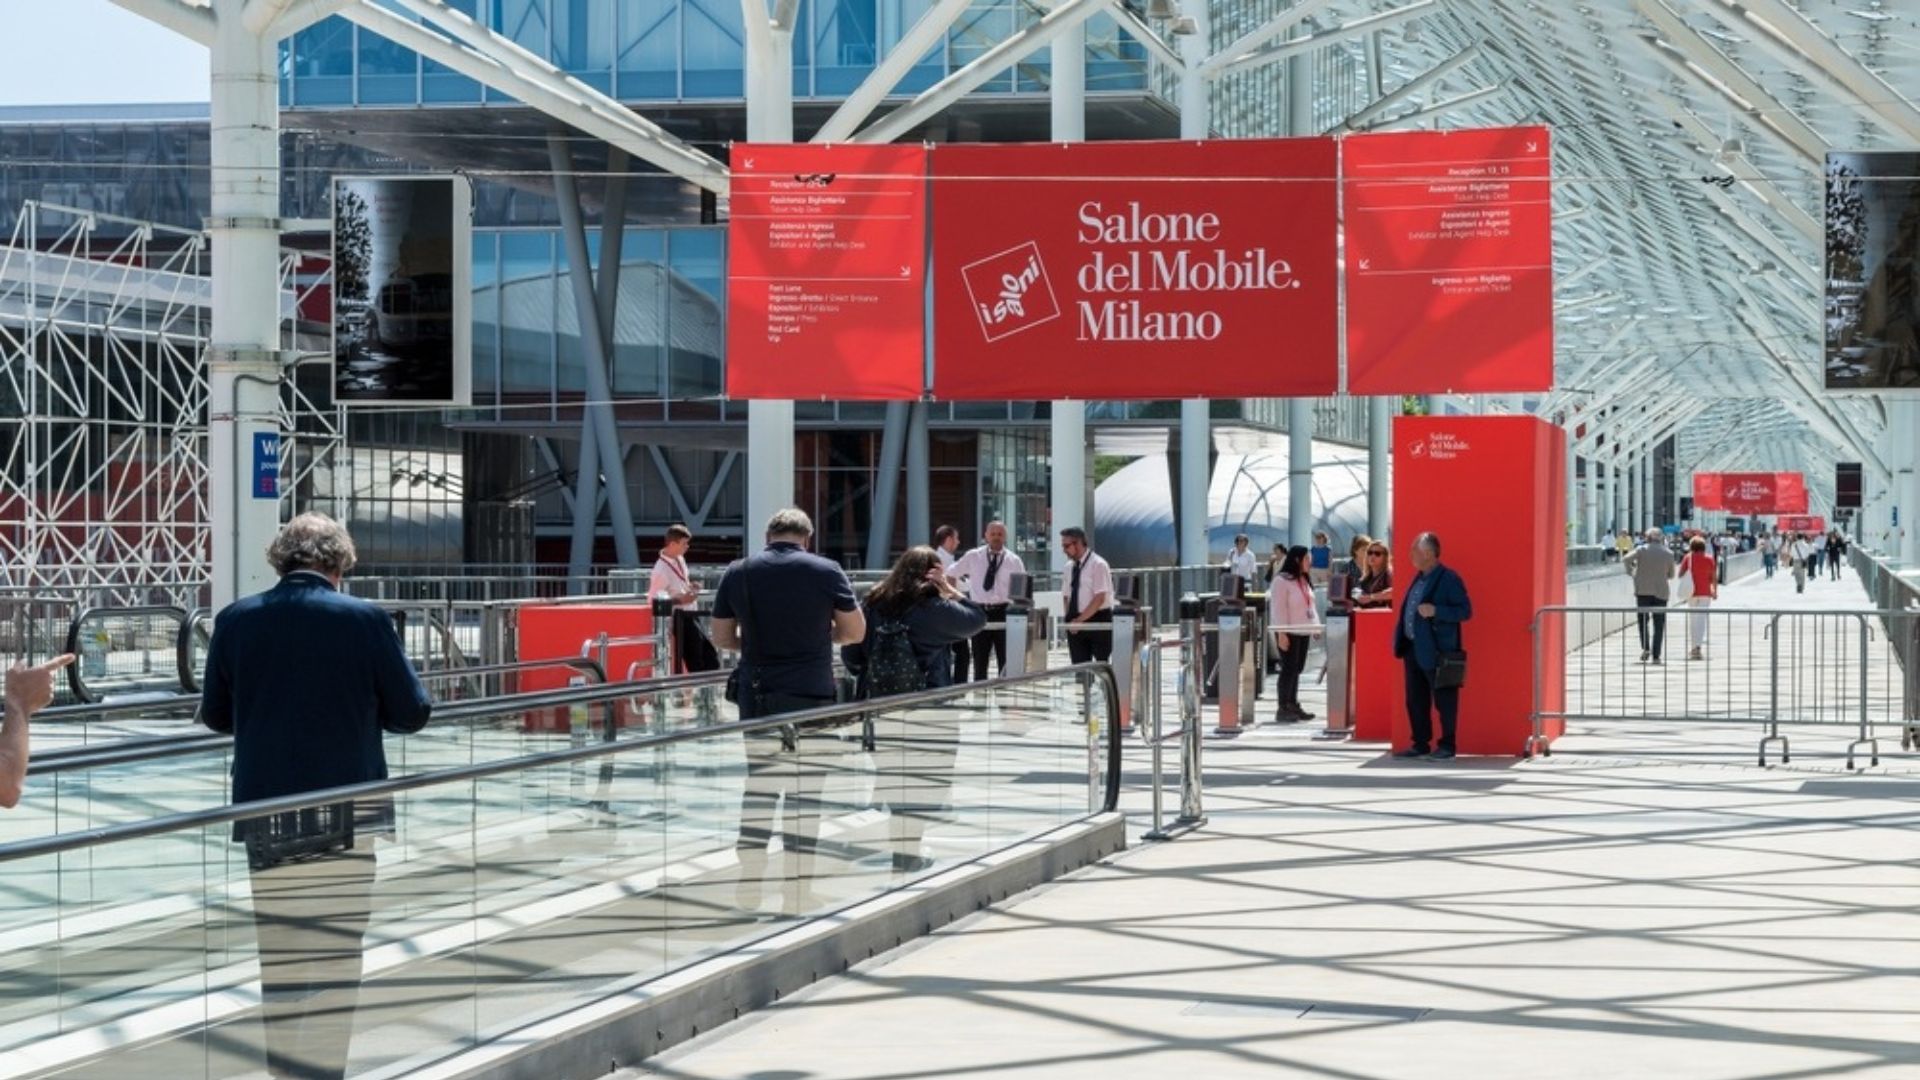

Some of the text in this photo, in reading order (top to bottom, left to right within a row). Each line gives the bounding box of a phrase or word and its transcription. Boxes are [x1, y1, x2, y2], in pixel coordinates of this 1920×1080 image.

[1448, 168, 1486, 176] Reception
[1428, 183, 1510, 193] Assistenza Biglietteria
[770, 196, 845, 205] Assistenza Biglietteria
[1441, 210, 1510, 219] Assistenza Ingressi
[770, 222, 833, 231] Assistenza Ingressi
[1078, 201, 1221, 244] Salone
[1440, 220, 1477, 229] Espositori
[1485, 219, 1511, 228] Agenti
[770, 231, 802, 240] Espositori
[812, 232, 835, 240] Agenti
[1439, 231, 1452, 239] and
[1454, 230, 1475, 239] Agent
[1493, 229, 1509, 237] Desk
[1077, 248, 1302, 292] del Mobile.
[1431, 277, 1463, 286] Ingresso
[1480, 275, 1511, 285] Biglietto
[769, 284, 802, 292] Fast Lane
[1443, 286, 1473, 295] Entrance
[1491, 284, 1511, 293] Ticket
[769, 294, 798, 303] Ingresso
[800, 294, 823, 302] diretto
[769, 304, 803, 313] Espositori
[768, 314, 795, 323] Stampa
[1076, 300, 1223, 341] Milano
[768, 325, 800, 333] Red Card
[767, 335, 780, 343] Vip
[1430, 432, 1456, 441] Salone
[1430, 450, 1456, 459] Milano
